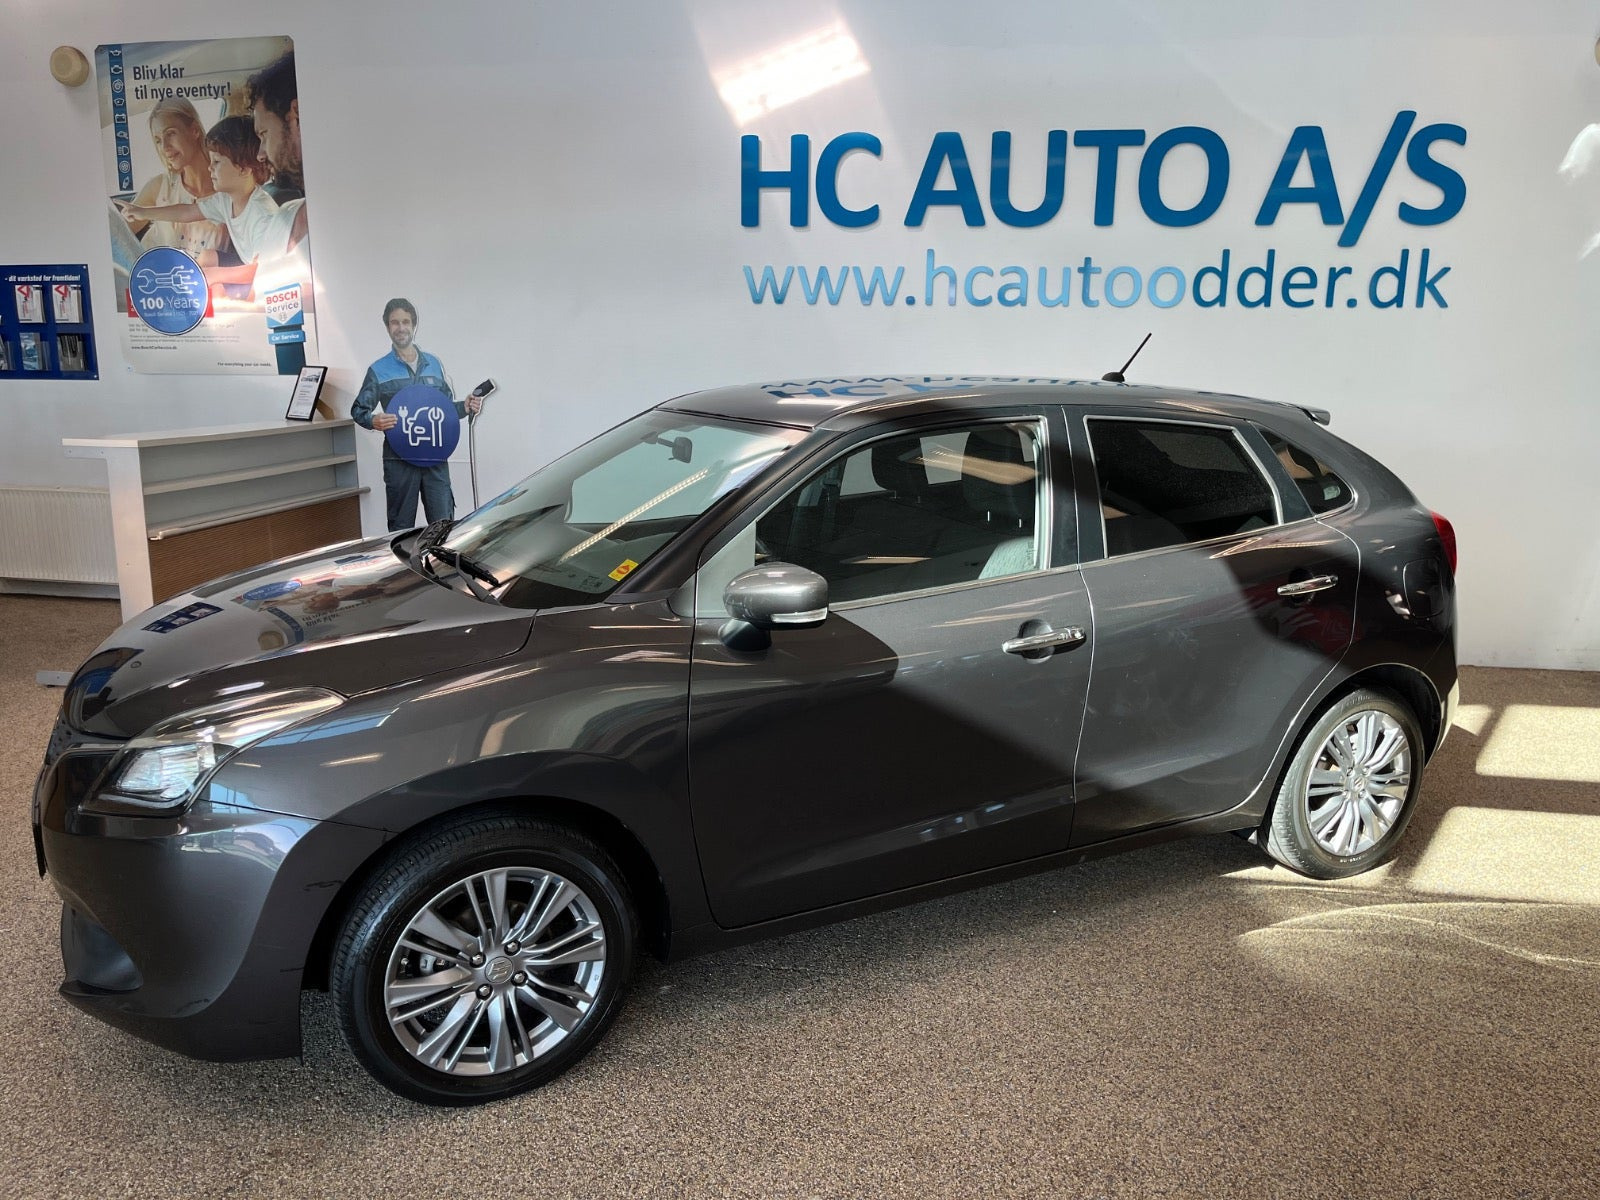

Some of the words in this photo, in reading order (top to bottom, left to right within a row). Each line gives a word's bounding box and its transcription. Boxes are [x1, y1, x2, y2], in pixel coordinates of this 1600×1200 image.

[133, 64, 158, 80] Bliv
[160, 63, 185, 79] klar
[134, 84, 148, 99] til
[150, 86, 173, 102] nye
[176, 82, 231, 99] eventyr!
[741, 132, 882, 228] HC
[904, 126, 1230, 229] AUTO
[1255, 110, 1467, 247] A/S
[742, 248, 1451, 309] www.hcautoodder.dk
[140, 297, 164, 310] 100
[166, 296, 200, 309] Years
[266, 290, 298, 304] BOSCH
[267, 302, 299, 313] Service
